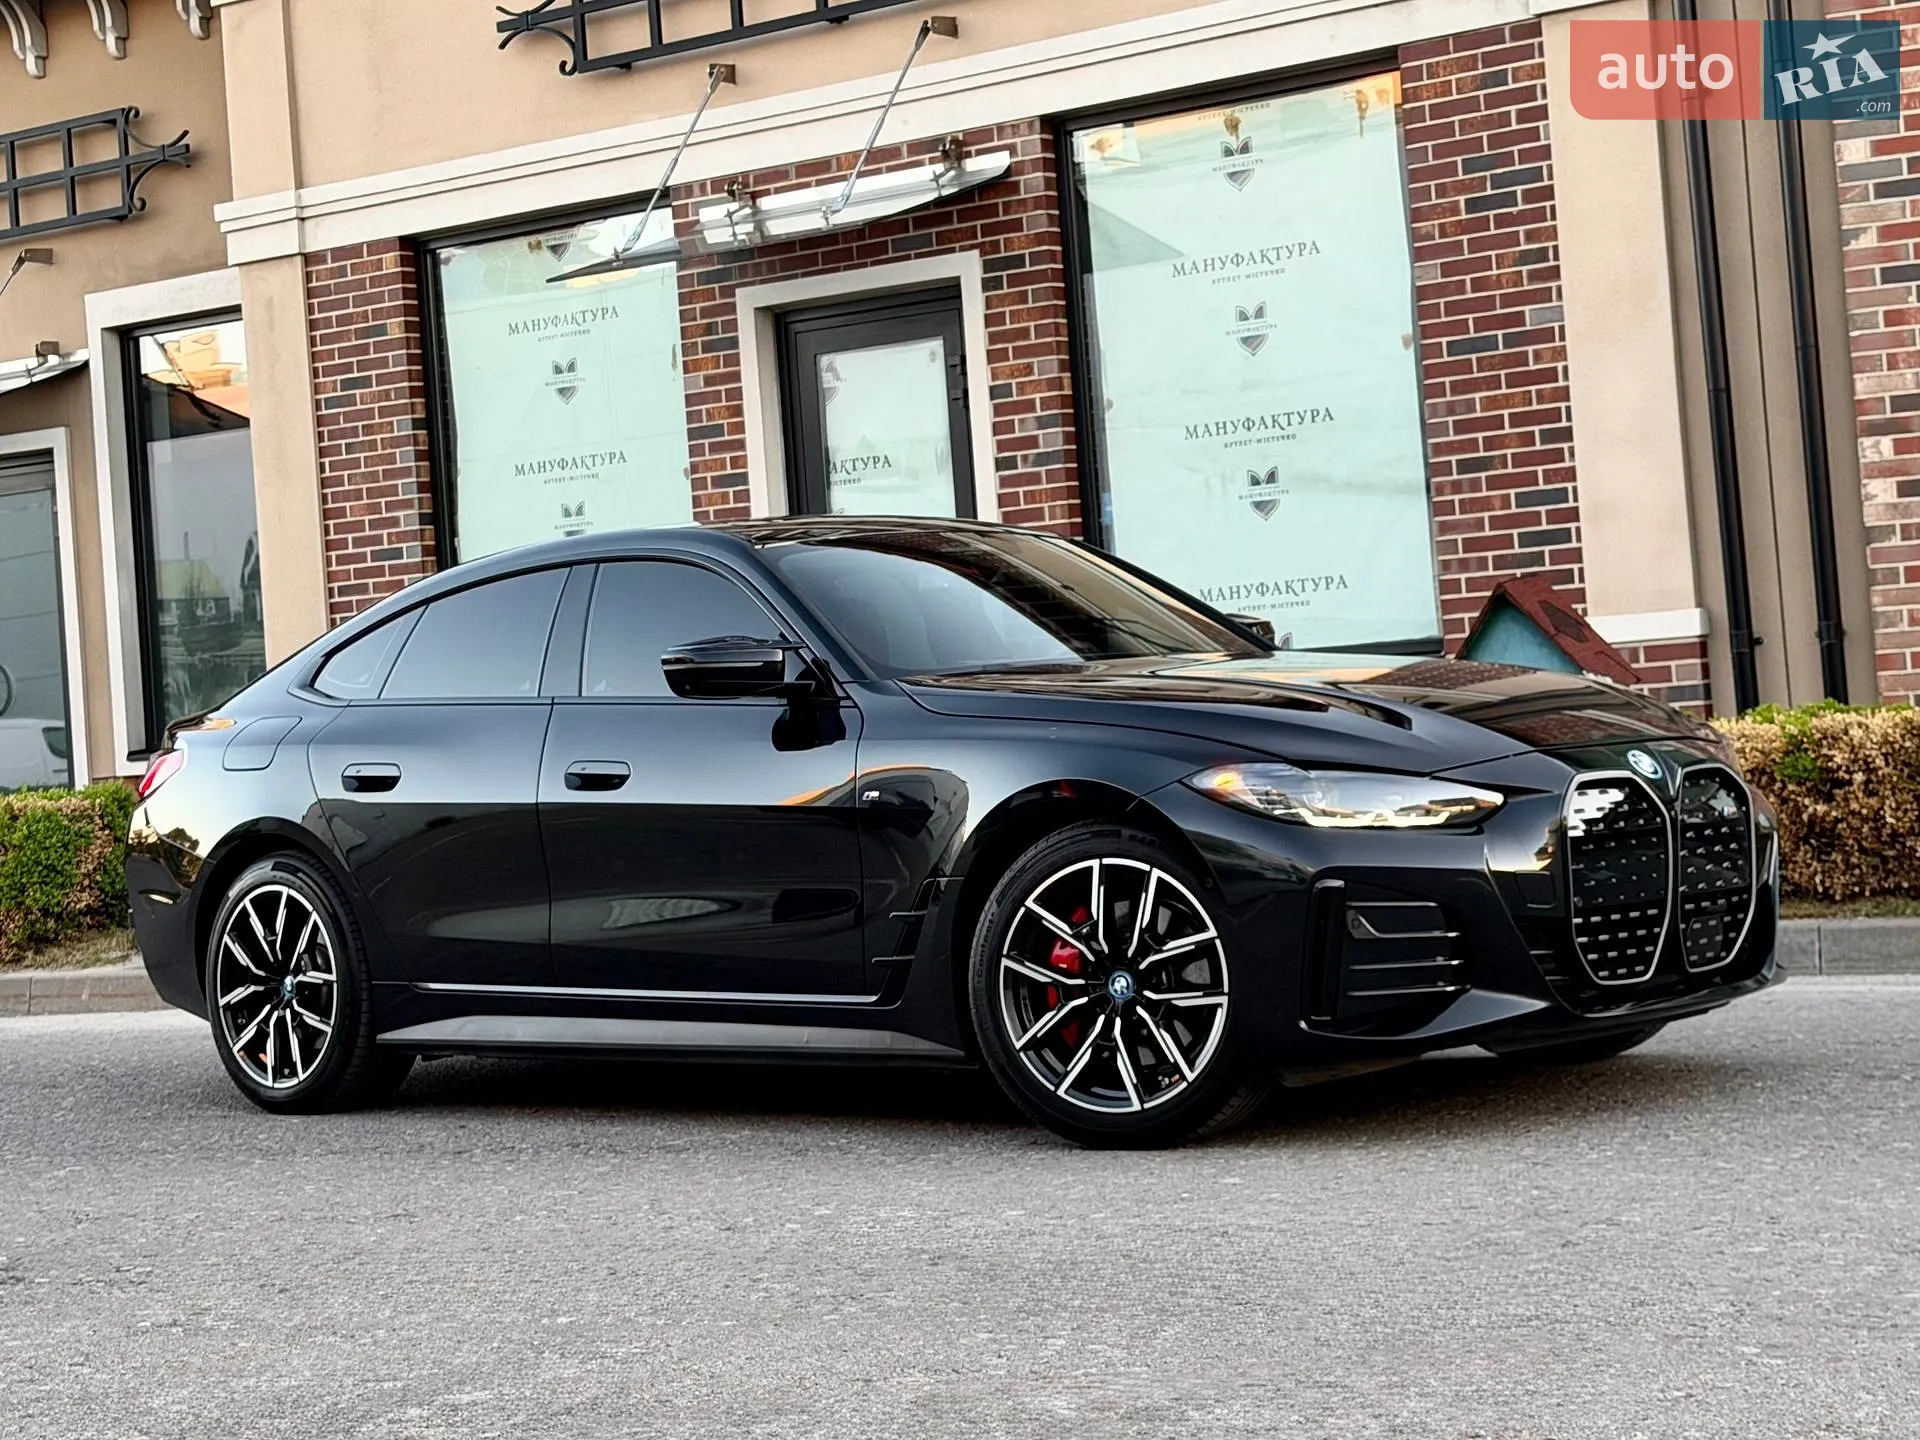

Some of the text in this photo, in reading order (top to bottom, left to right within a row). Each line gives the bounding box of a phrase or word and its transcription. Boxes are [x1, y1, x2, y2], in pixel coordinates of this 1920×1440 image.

[1172, 240, 1321, 278] МАНУФАКТУРА
[508, 305, 620, 336] МАНУФАКТУРА
[1184, 406, 1334, 441] МАНУФАКТУРА
[514, 449, 628, 477] МАНУФАКТУРА
[1199, 573, 1349, 602] МАНУФАКТУРА
